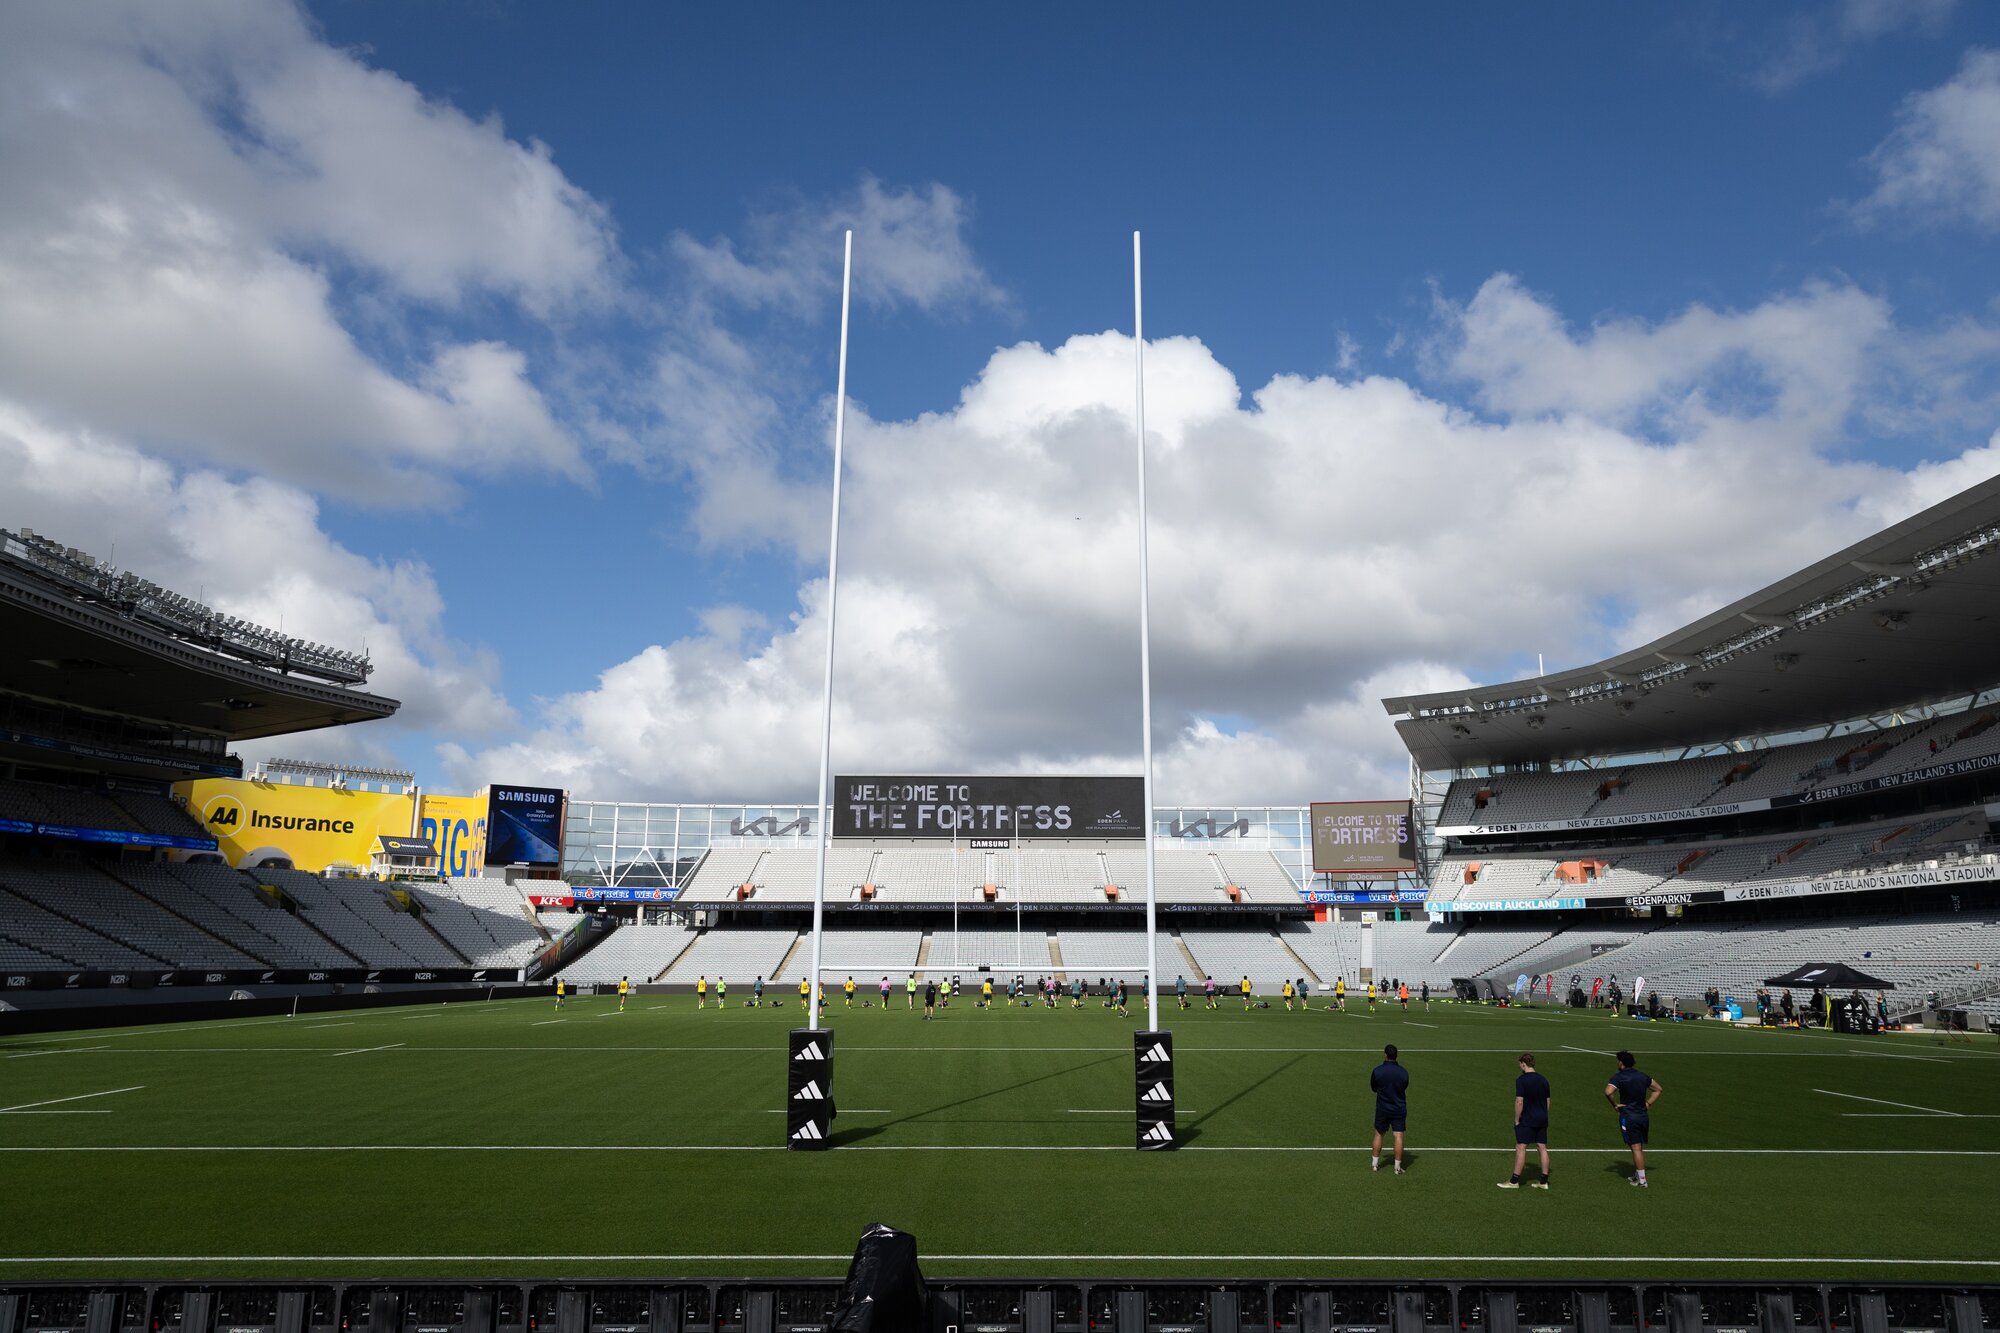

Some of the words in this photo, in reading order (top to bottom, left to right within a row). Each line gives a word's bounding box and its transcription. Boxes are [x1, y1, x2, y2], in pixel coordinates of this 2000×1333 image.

[120, 752, 132, 760] Rau
[132, 756, 164, 768] University
[172, 760, 200, 770] Auckland
[1815, 787, 1838, 800] EDEN
[1840, 782, 1865, 796] PARK
[1879, 775, 1900, 787] NEW
[1902, 764, 1955, 783] ZEALAND'S
[498, 791, 555, 804] SAMSUNG
[850, 785, 938, 801] WELCOME
[946, 785, 970, 801] TO
[208, 806, 238, 825] AA
[251, 810, 354, 833] Insurance
[849, 805, 906, 829] THE
[918, 805, 1072, 829] FORTRESS
[1318, 816, 1364, 826] WELCOME
[1368, 815, 1381, 826] TO
[1385, 814, 1405, 825] THE
[1488, 824, 1517, 832] EDEN
[1520, 822, 1550, 831] PARK
[1567, 820, 1590, 828] NEW
[1593, 814, 1646, 826] ZEALAND'S
[1649, 810, 1697, 822] NATIONAL
[1700, 804, 1740, 817] STADIUM
[1318, 828, 1408, 844] FORTRESS
[1749, 888, 1771, 898] EDEN
[1773, 885, 1797, 896] PARK
[1811, 882, 1831, 893] NEW
[1834, 876, 1885, 891] ZEALAND'S
[1888, 872, 1941, 886] NATIONAL
[1944, 867, 1995, 882] STADIUM
[1453, 902, 1502, 910] DISCOVER
[1504, 900, 1559, 909] AUCKLAND
[1625, 894, 1692, 906] @EDENPARKNZ
